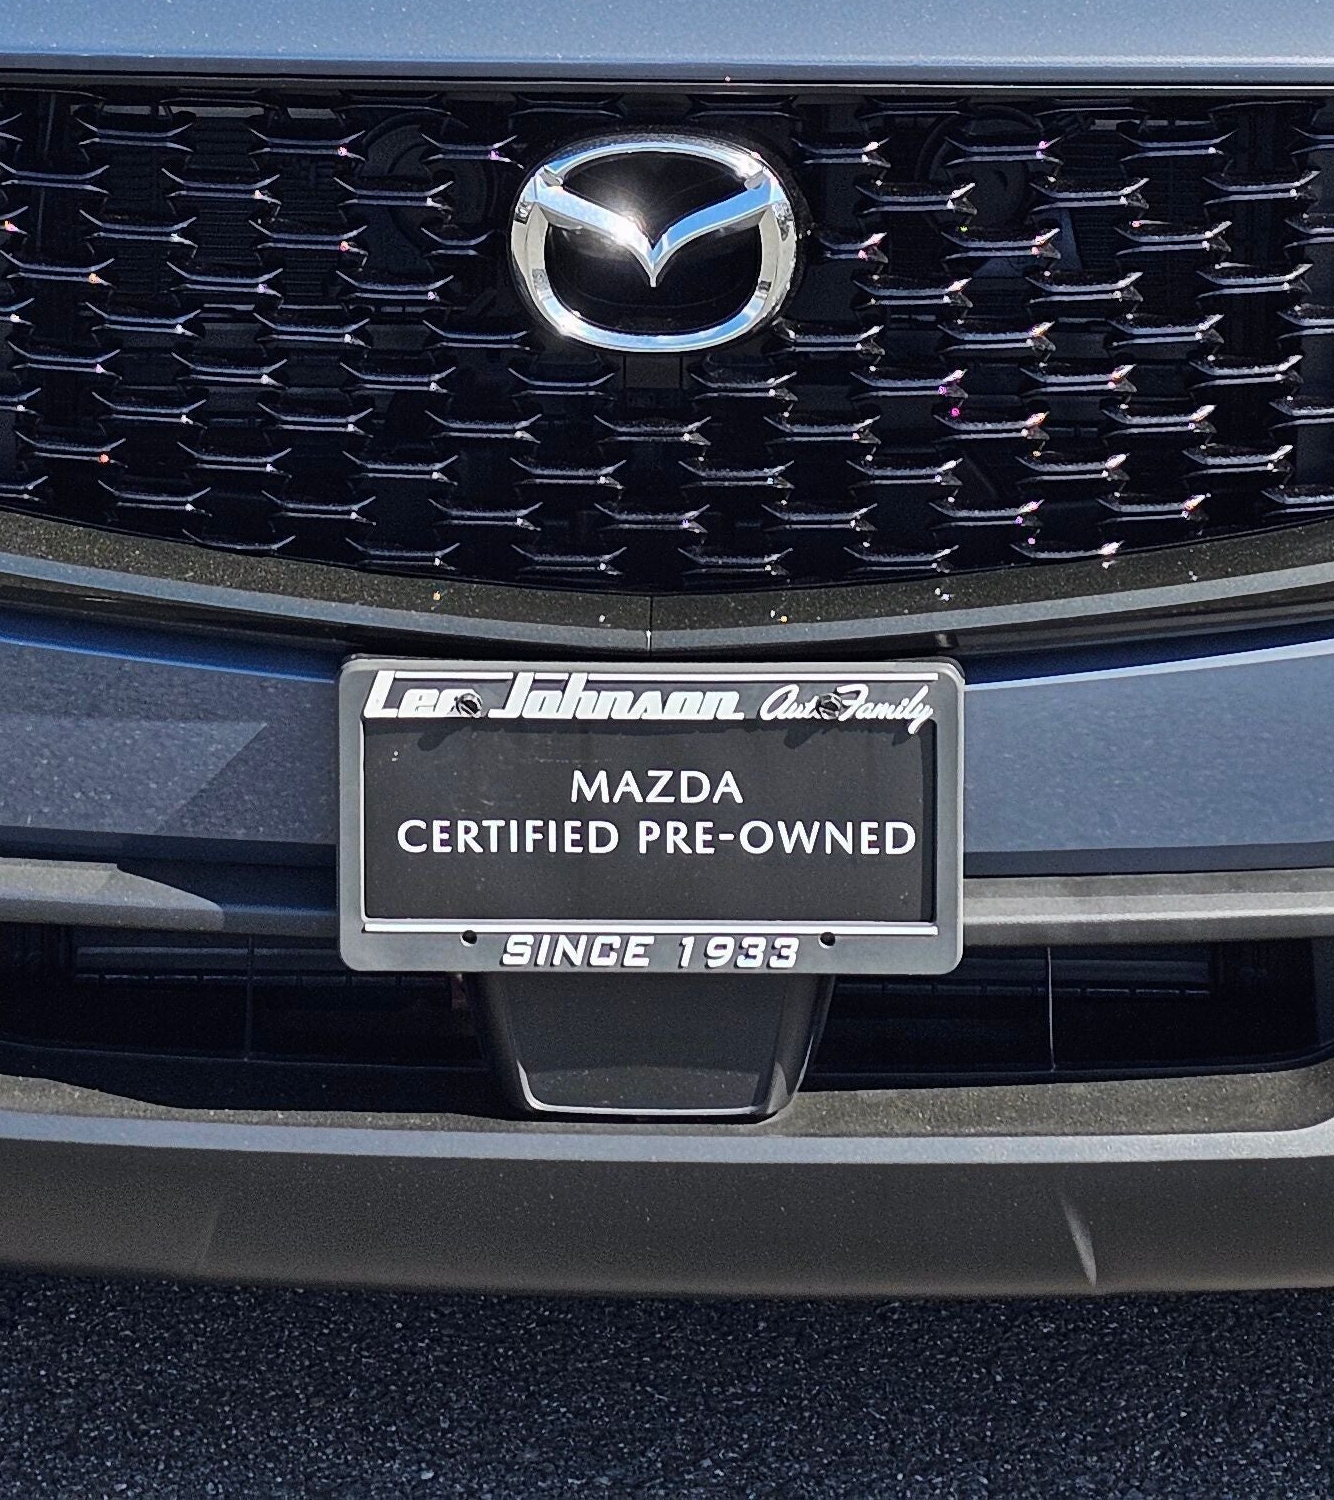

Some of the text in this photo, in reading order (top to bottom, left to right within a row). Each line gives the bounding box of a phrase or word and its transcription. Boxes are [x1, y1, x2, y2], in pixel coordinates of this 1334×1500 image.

[487, 671, 745, 720] Johnson
[759, 684, 835, 721] Aut
[835, 683, 934, 735] Family
[570, 769, 744, 804] MAZDA
[397, 819, 916, 855] CERTIFIED PRE-OWNED
[499, 934, 800, 969] SINCE 1933
